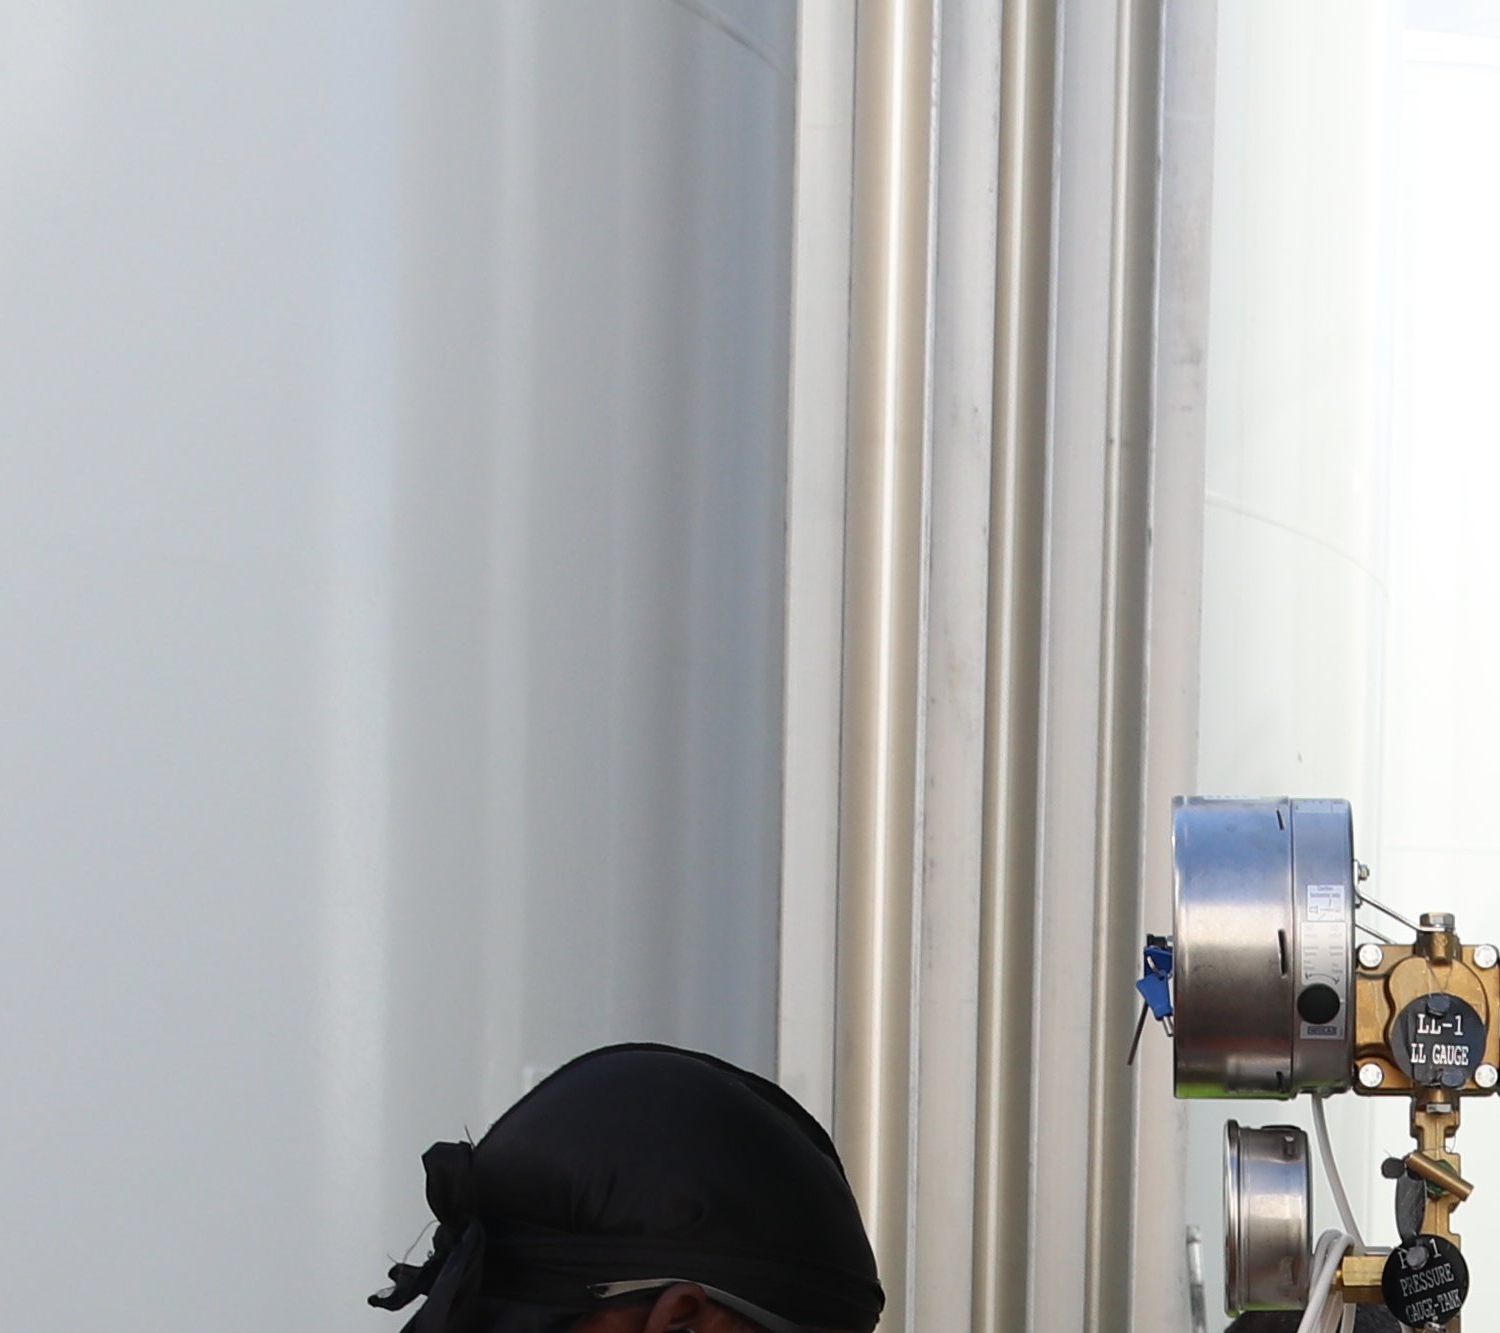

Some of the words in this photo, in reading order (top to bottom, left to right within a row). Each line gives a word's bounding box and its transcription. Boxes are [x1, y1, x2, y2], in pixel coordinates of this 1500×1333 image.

[1417, 1012, 1464, 1036] LL-1
[1410, 1042, 1427, 1064] LL
[1432, 1043, 1469, 1066] GAUGE
[1400, 1262, 1455, 1297] PRESSURE
[1405, 1288, 1462, 1324] GAUGE-TANK
